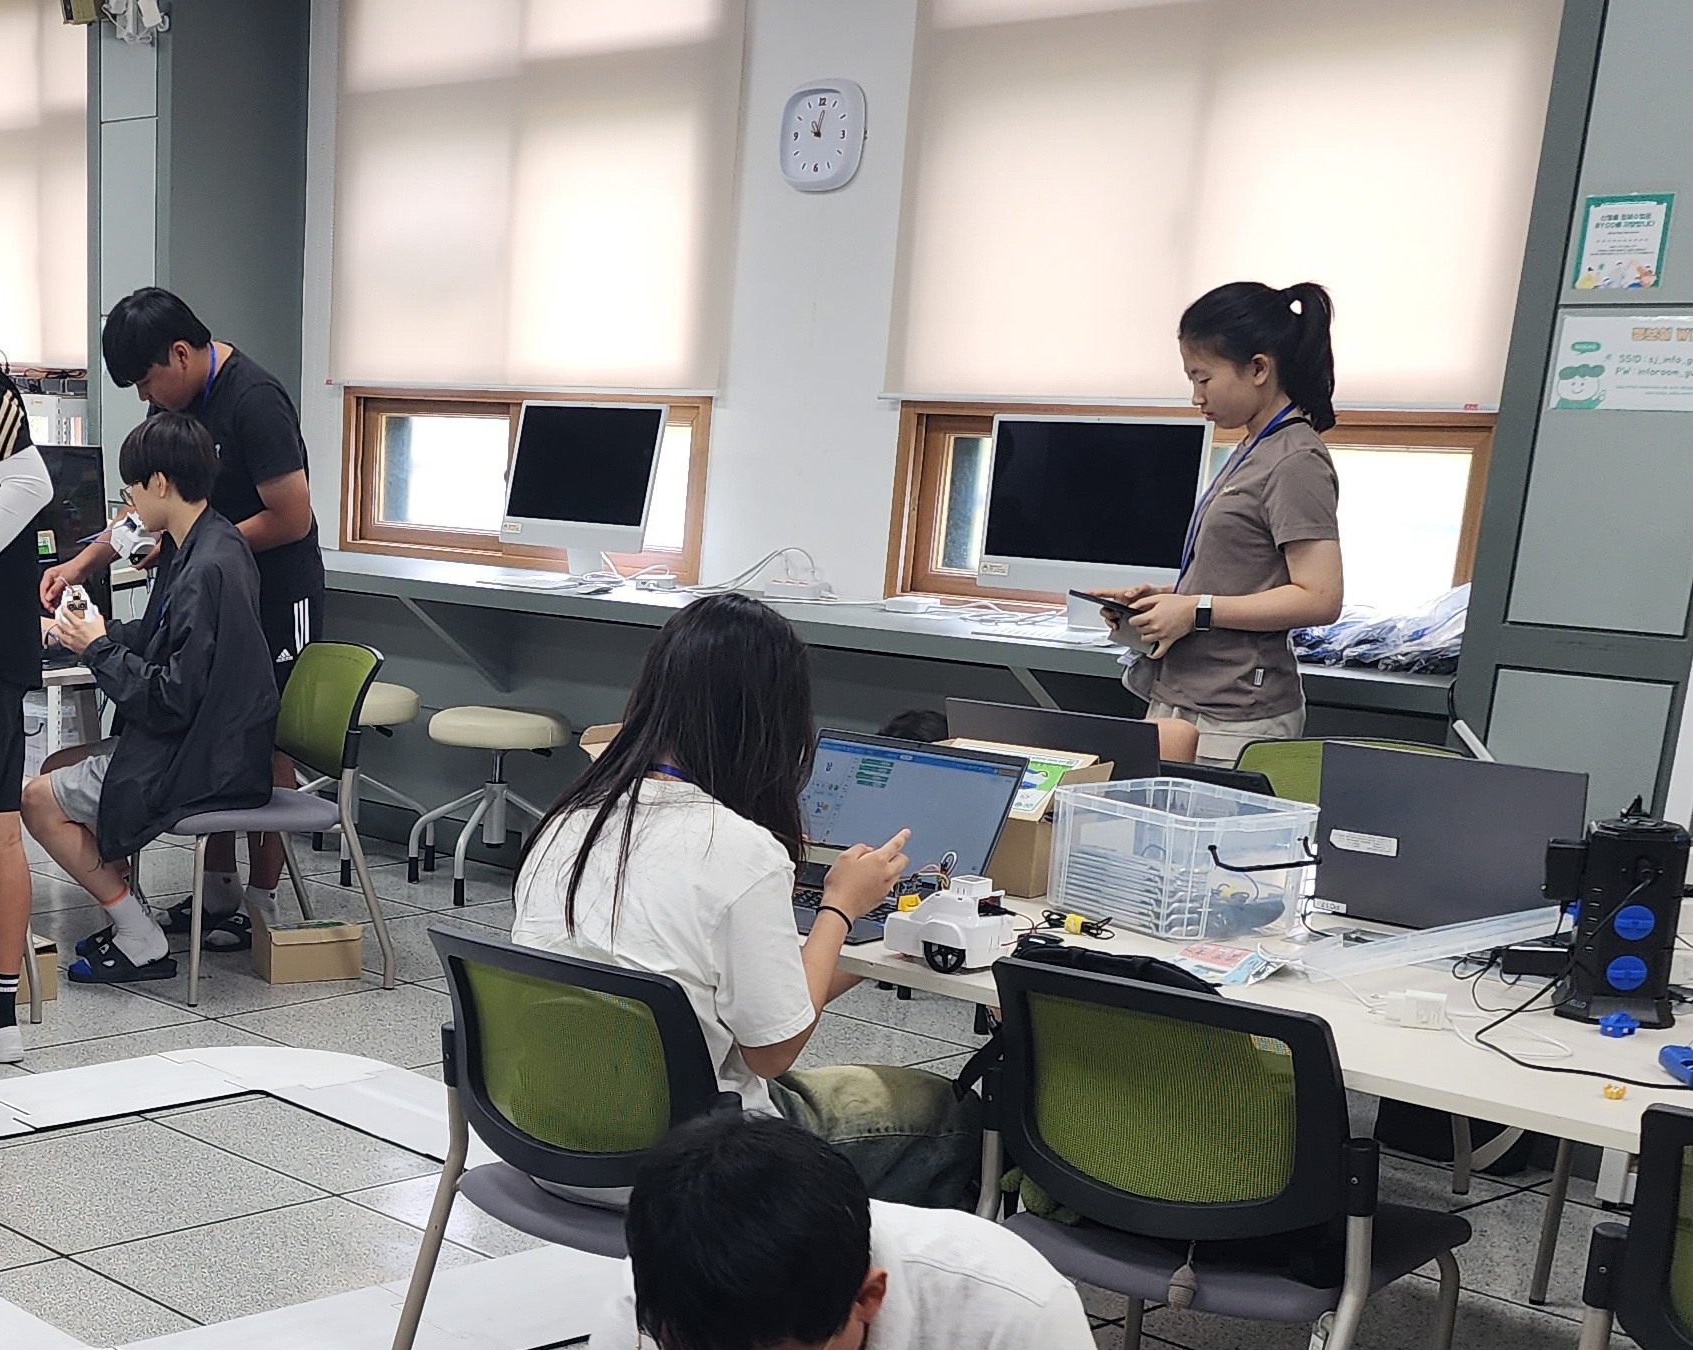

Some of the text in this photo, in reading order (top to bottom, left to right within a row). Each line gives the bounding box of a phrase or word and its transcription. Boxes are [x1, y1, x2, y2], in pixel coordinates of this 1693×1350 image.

[818, 97, 827, 106] 12
[793, 131, 799, 141] 9
[840, 129, 846, 139] 3
[813, 163, 819, 172] 6
[1619, 354, 1642, 364] SSID
